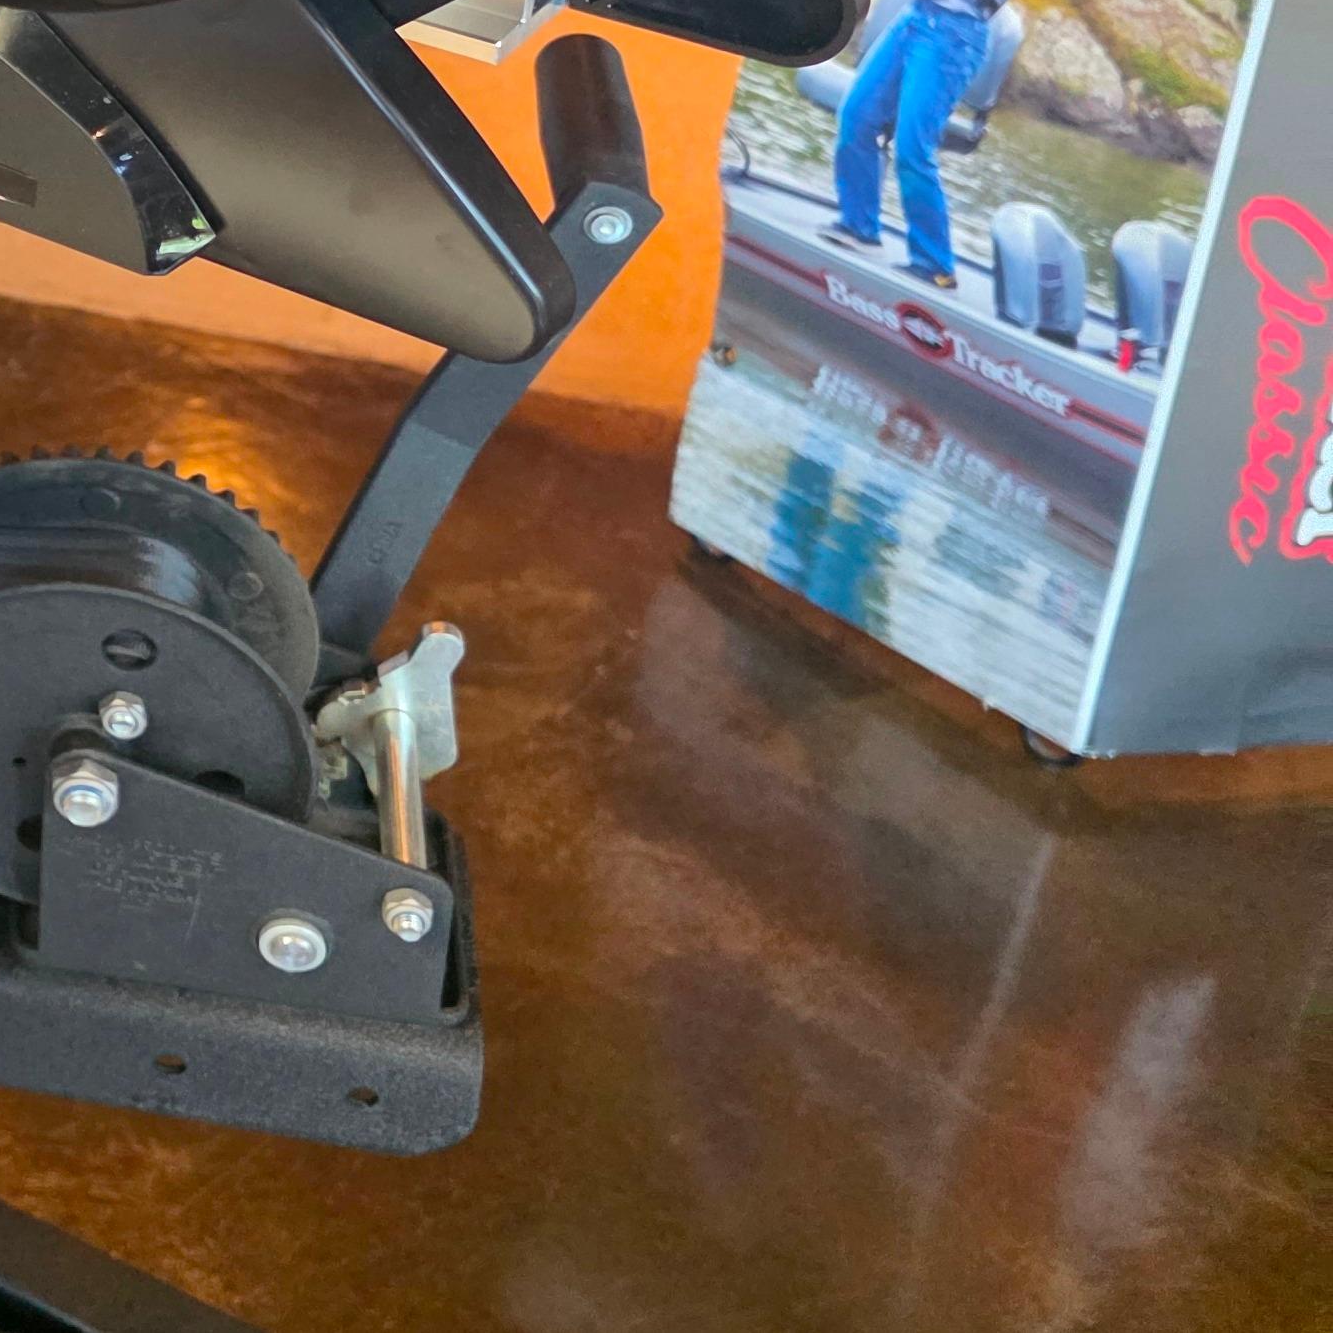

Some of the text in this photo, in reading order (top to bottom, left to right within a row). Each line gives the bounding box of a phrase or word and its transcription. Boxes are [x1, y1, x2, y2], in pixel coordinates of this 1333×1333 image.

[823, 273, 902, 332] Bass
[941, 326, 1073, 418] Tracker
[1228, 194, 1333, 566] Classic
